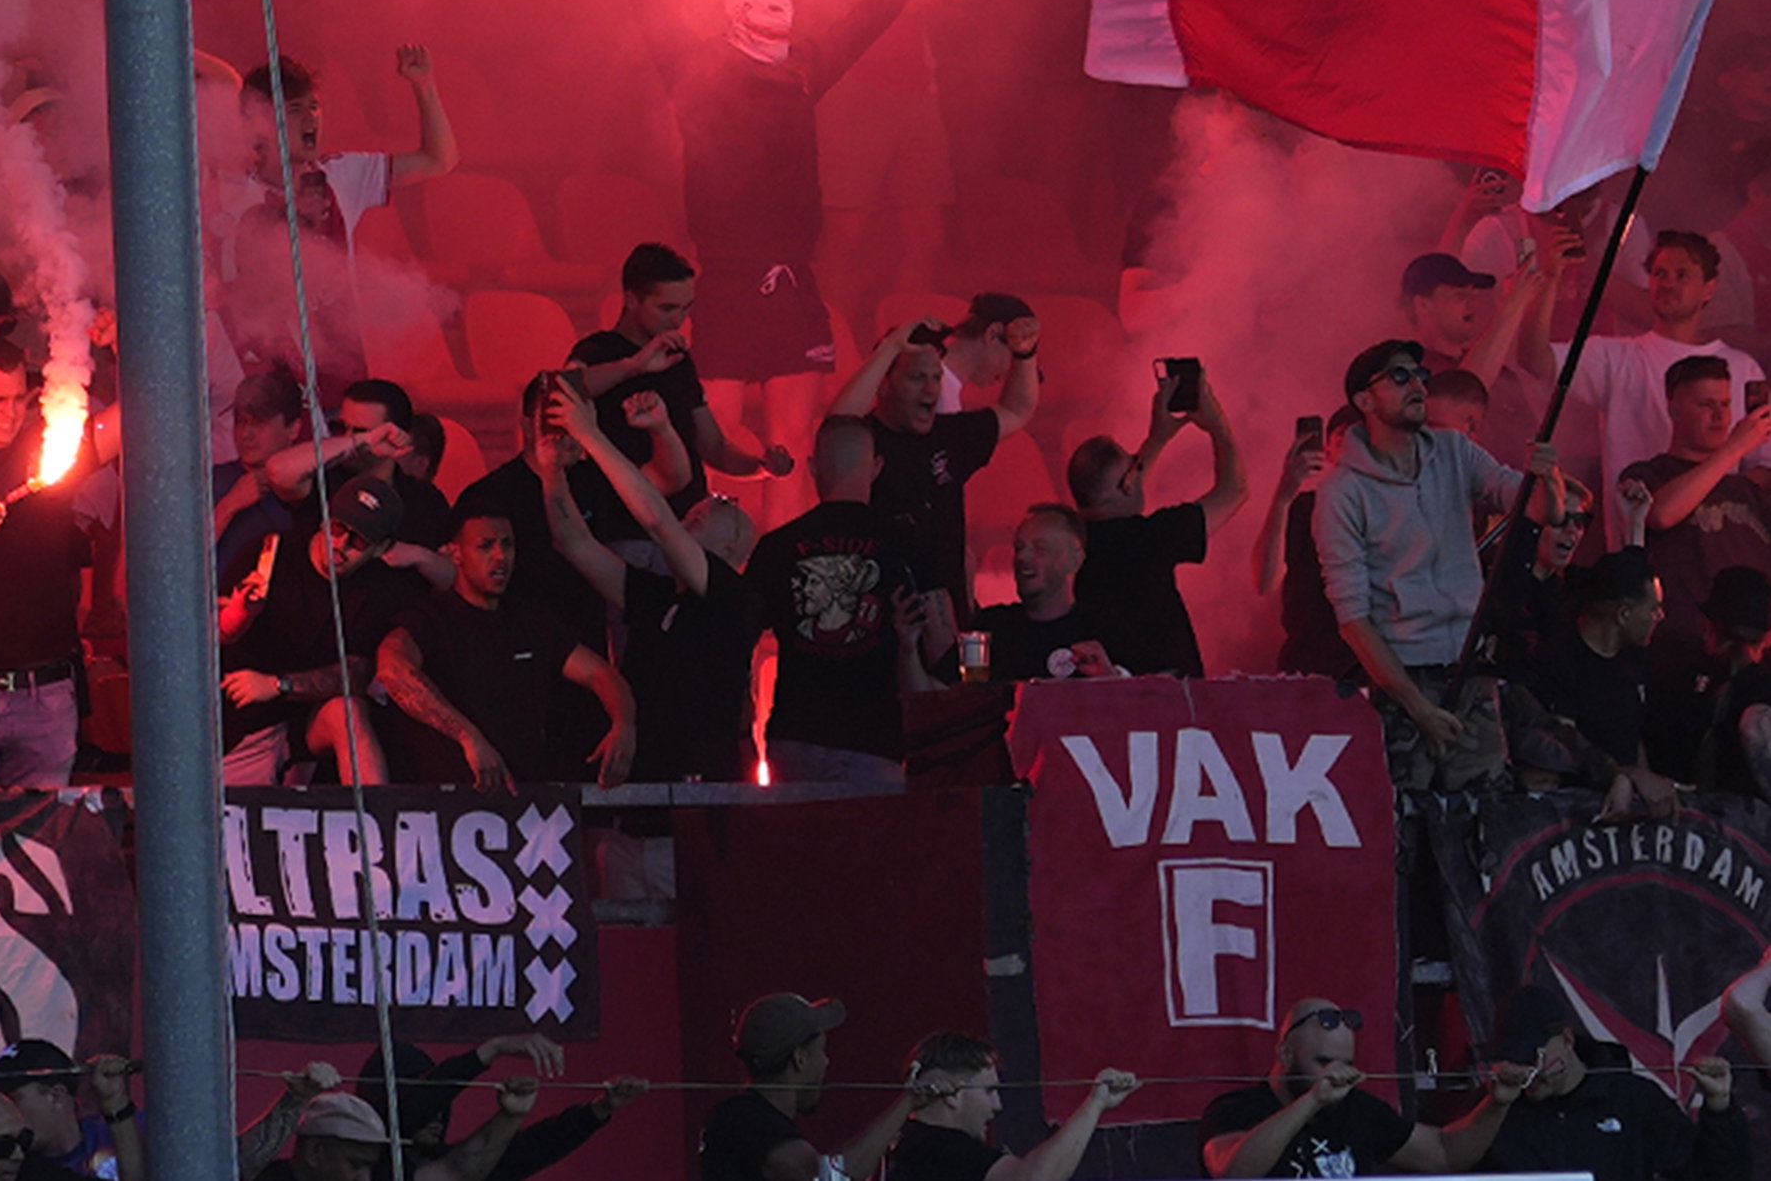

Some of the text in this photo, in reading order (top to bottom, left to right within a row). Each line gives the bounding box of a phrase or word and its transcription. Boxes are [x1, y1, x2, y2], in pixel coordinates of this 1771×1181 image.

[1061, 728, 1362, 849] VAK
[224, 804, 518, 925] LTRAS
[1531, 824, 1764, 910] AMSTERDAM
[228, 922, 517, 1007] MSTERDAM
[1173, 867, 1264, 1016] F
